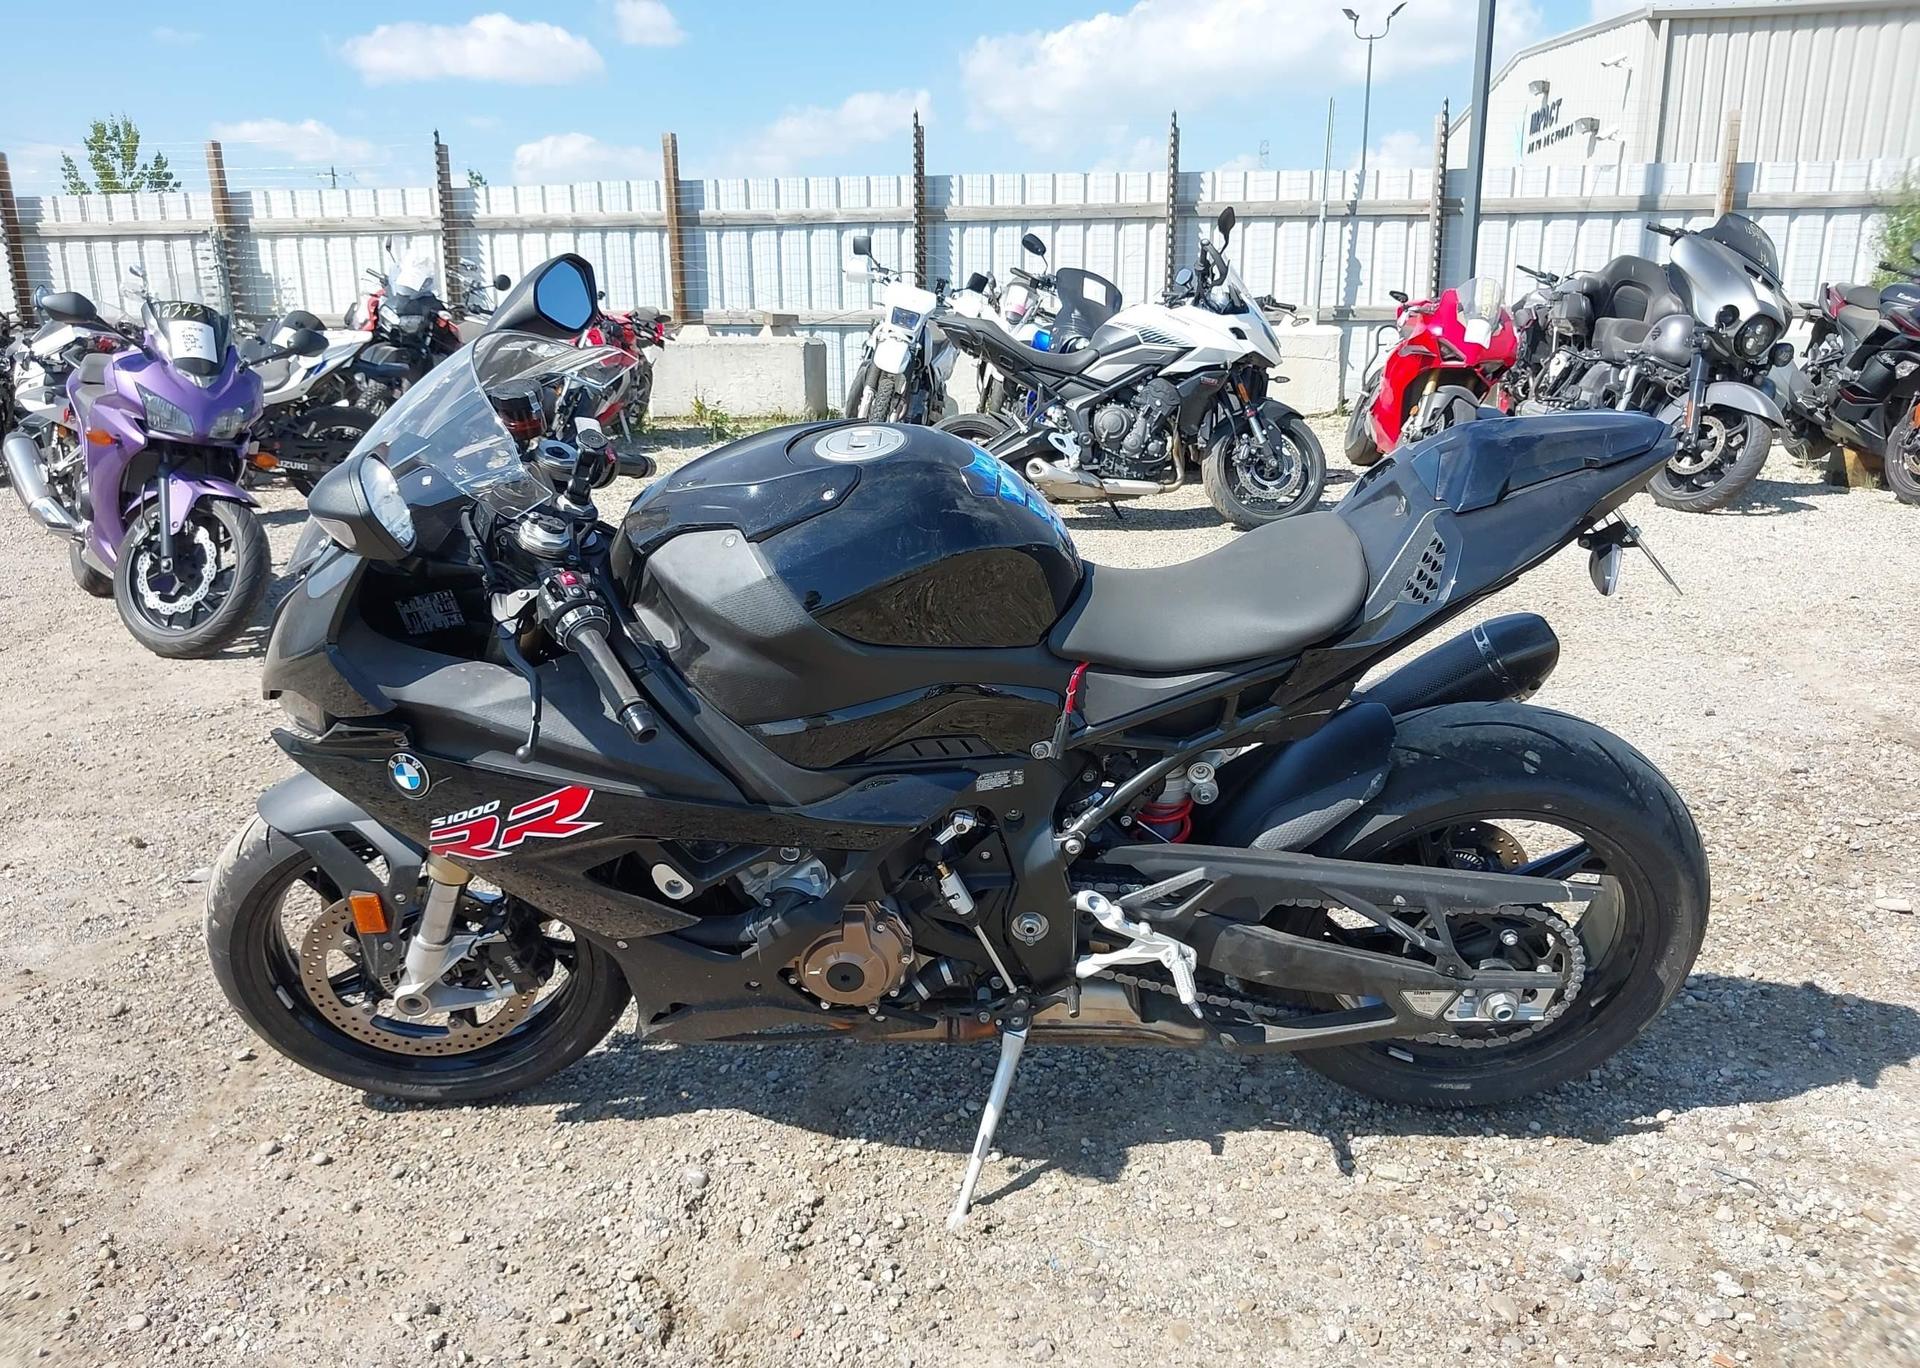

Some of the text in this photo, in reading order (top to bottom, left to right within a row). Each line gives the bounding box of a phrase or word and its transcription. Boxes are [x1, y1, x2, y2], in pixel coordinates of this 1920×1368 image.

[276, 460, 308, 471] UZUKI
[389, 755, 421, 769] BMW
[429, 784, 604, 861] RR
[430, 799, 501, 828] S1000
